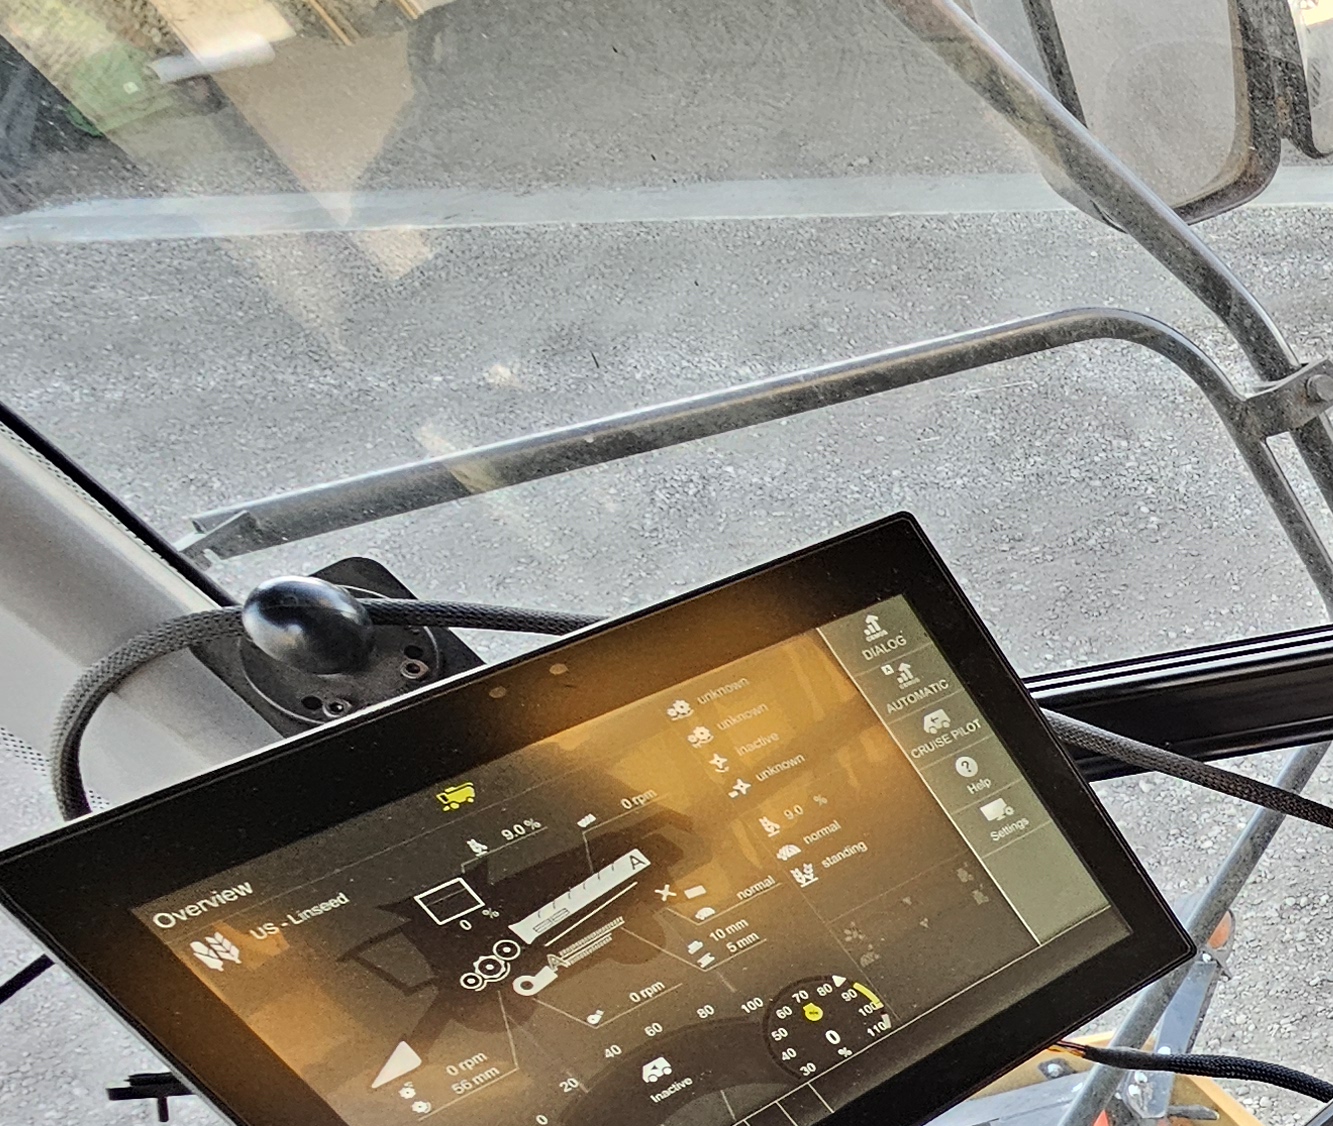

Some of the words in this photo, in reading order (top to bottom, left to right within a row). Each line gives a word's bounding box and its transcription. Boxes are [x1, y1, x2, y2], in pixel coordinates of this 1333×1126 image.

[862, 635, 907, 660] DIALOG
[697, 677, 749, 704] unknown
[886, 679, 949, 714] AUTOMATIC
[717, 703, 769, 731] unknown
[910, 732, 952, 759] CRUISE
[950, 719, 981, 742] PILOT
[755, 753, 806, 782] unknown
[633, 788, 658, 808] rpm
[966, 778, 992, 795] Help
[784, 804, 803, 821] 9.0
[813, 794, 828, 808] %
[501, 823, 526, 841] 9.0
[523, 818, 542, 830] %
[803, 820, 842, 845] normal
[990, 816, 1029, 842] Settings
[821, 841, 868, 869] standing
[736, 875, 776, 900] normal
[152, 881, 254, 929] Overview
[249, 920, 280, 940] US
[289, 892, 350, 925] Linseed
[459, 919, 473, 931] 0
[709, 928, 726, 943] 10
[725, 917, 749, 936] mm
[726, 941, 738, 954] 5
[736, 931, 760, 948] mm
[629, 991, 642, 1004] 0
[641, 980, 666, 1000] rpm
[791, 990, 809, 1004] 70
[816, 983, 833, 997] 80
[841, 988, 858, 1002] 90
[697, 1004, 715, 1019] 80
[741, 997, 764, 1015] 100
[776, 1005, 793, 1019] 60
[858, 1001, 880, 1017] 100
[644, 1023, 663, 1038] 60
[771, 1027, 788, 1041] 50
[825, 1029, 841, 1044] 0
[867, 1021, 888, 1037] 110
[604, 1044, 622, 1059] 40
[781, 1047, 797, 1061] 40
[445, 1064, 459, 1077] 0
[459, 1051, 488, 1073] rpm
[800, 1062, 816, 1076] 30
[451, 1079, 474, 1096] 56
[473, 1064, 501, 1085] mm
[559, 1077, 579, 1093] 20
[650, 1076, 693, 1103] Inactive
[535, 1114, 549, 1126] 0
